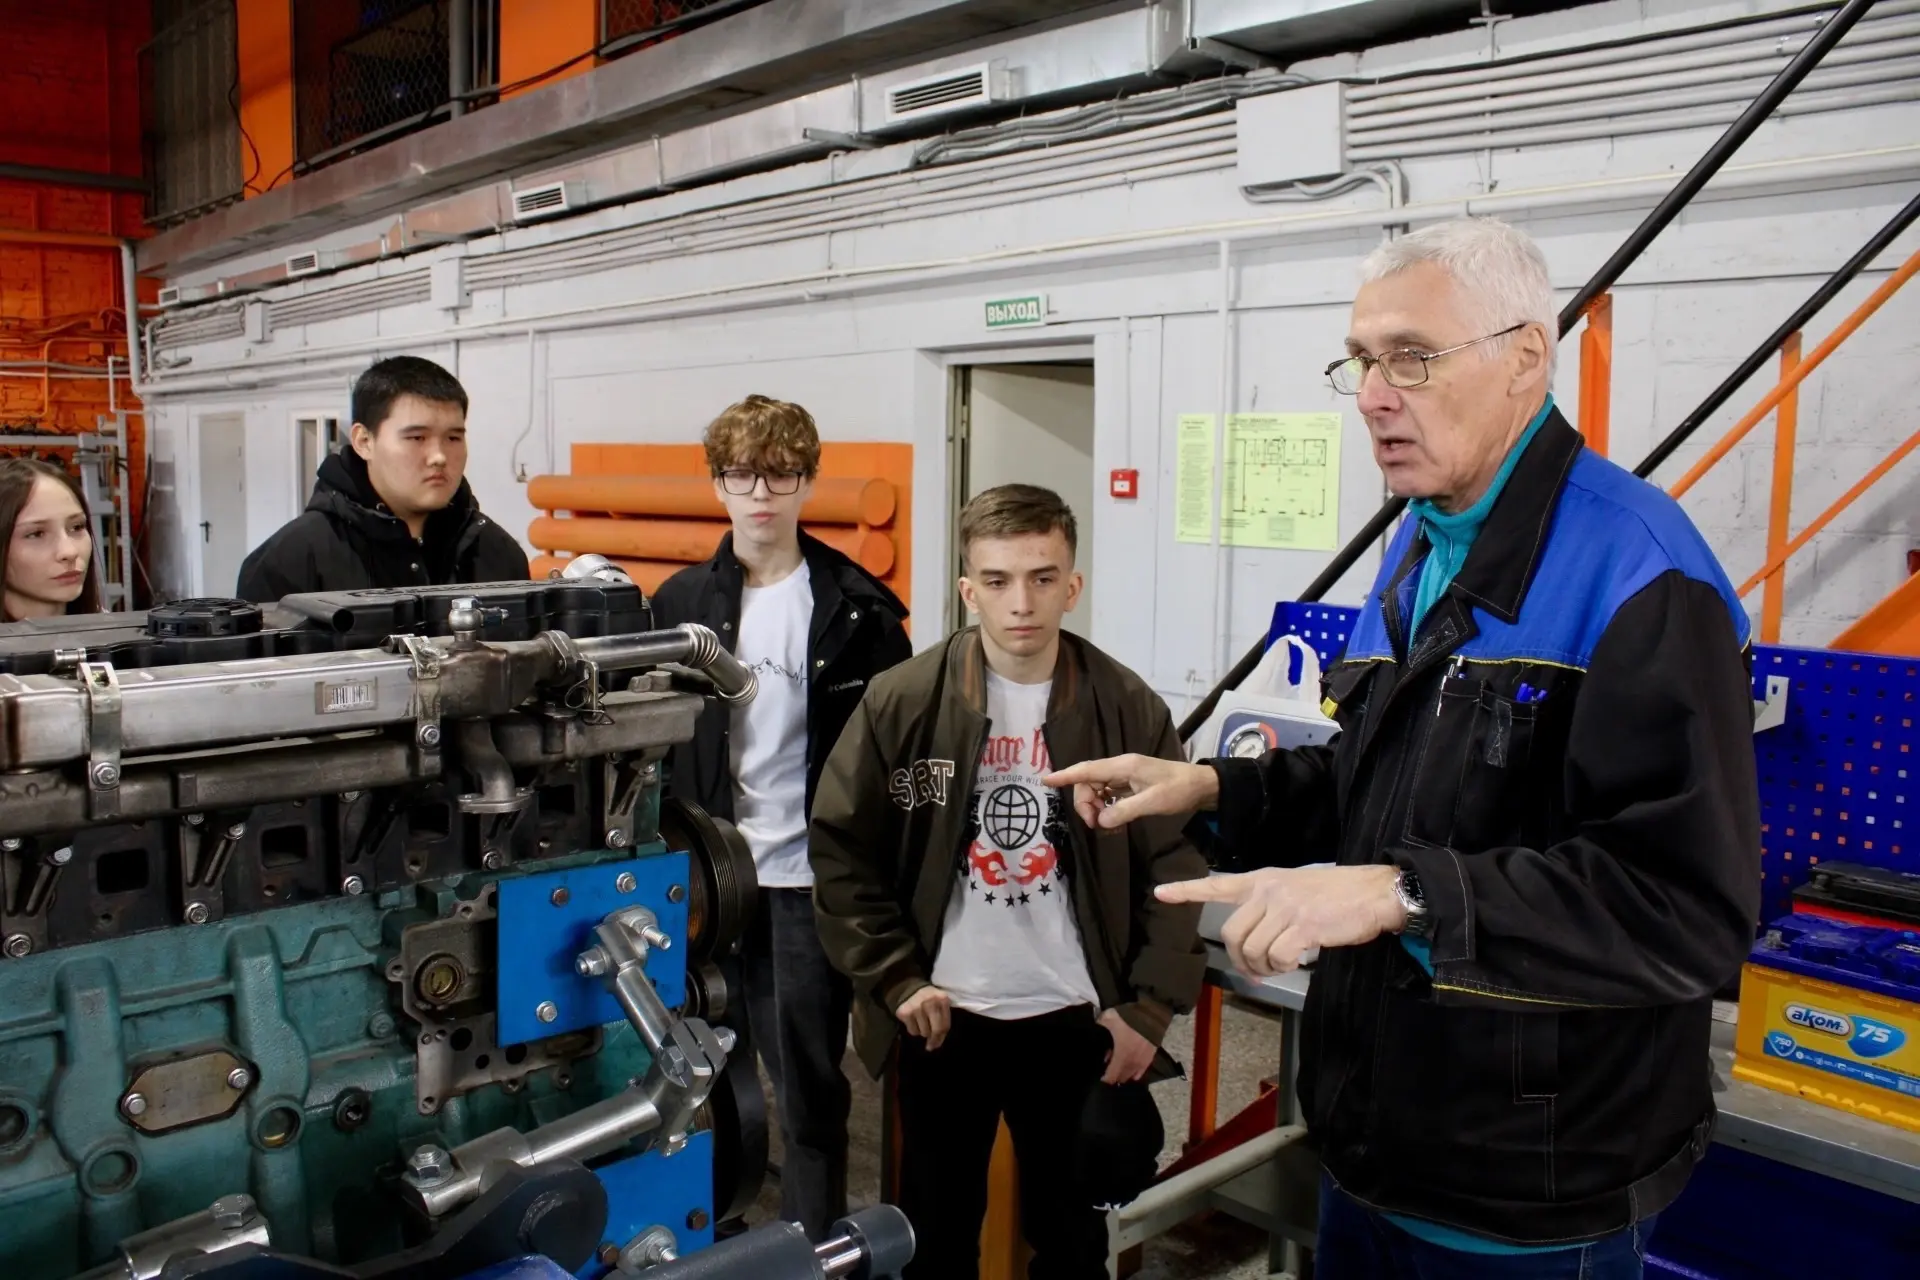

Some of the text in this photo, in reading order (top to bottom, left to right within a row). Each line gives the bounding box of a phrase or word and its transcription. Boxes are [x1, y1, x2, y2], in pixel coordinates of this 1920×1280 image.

[987, 300, 1039, 323] ВЫХОД
[981, 735, 1026, 773] age
[889, 759, 955, 811] SRT
[976, 775, 999, 785] RACE
[1001, 774, 1023, 782] YOUR
[1858, 1023, 1892, 1044] 75
